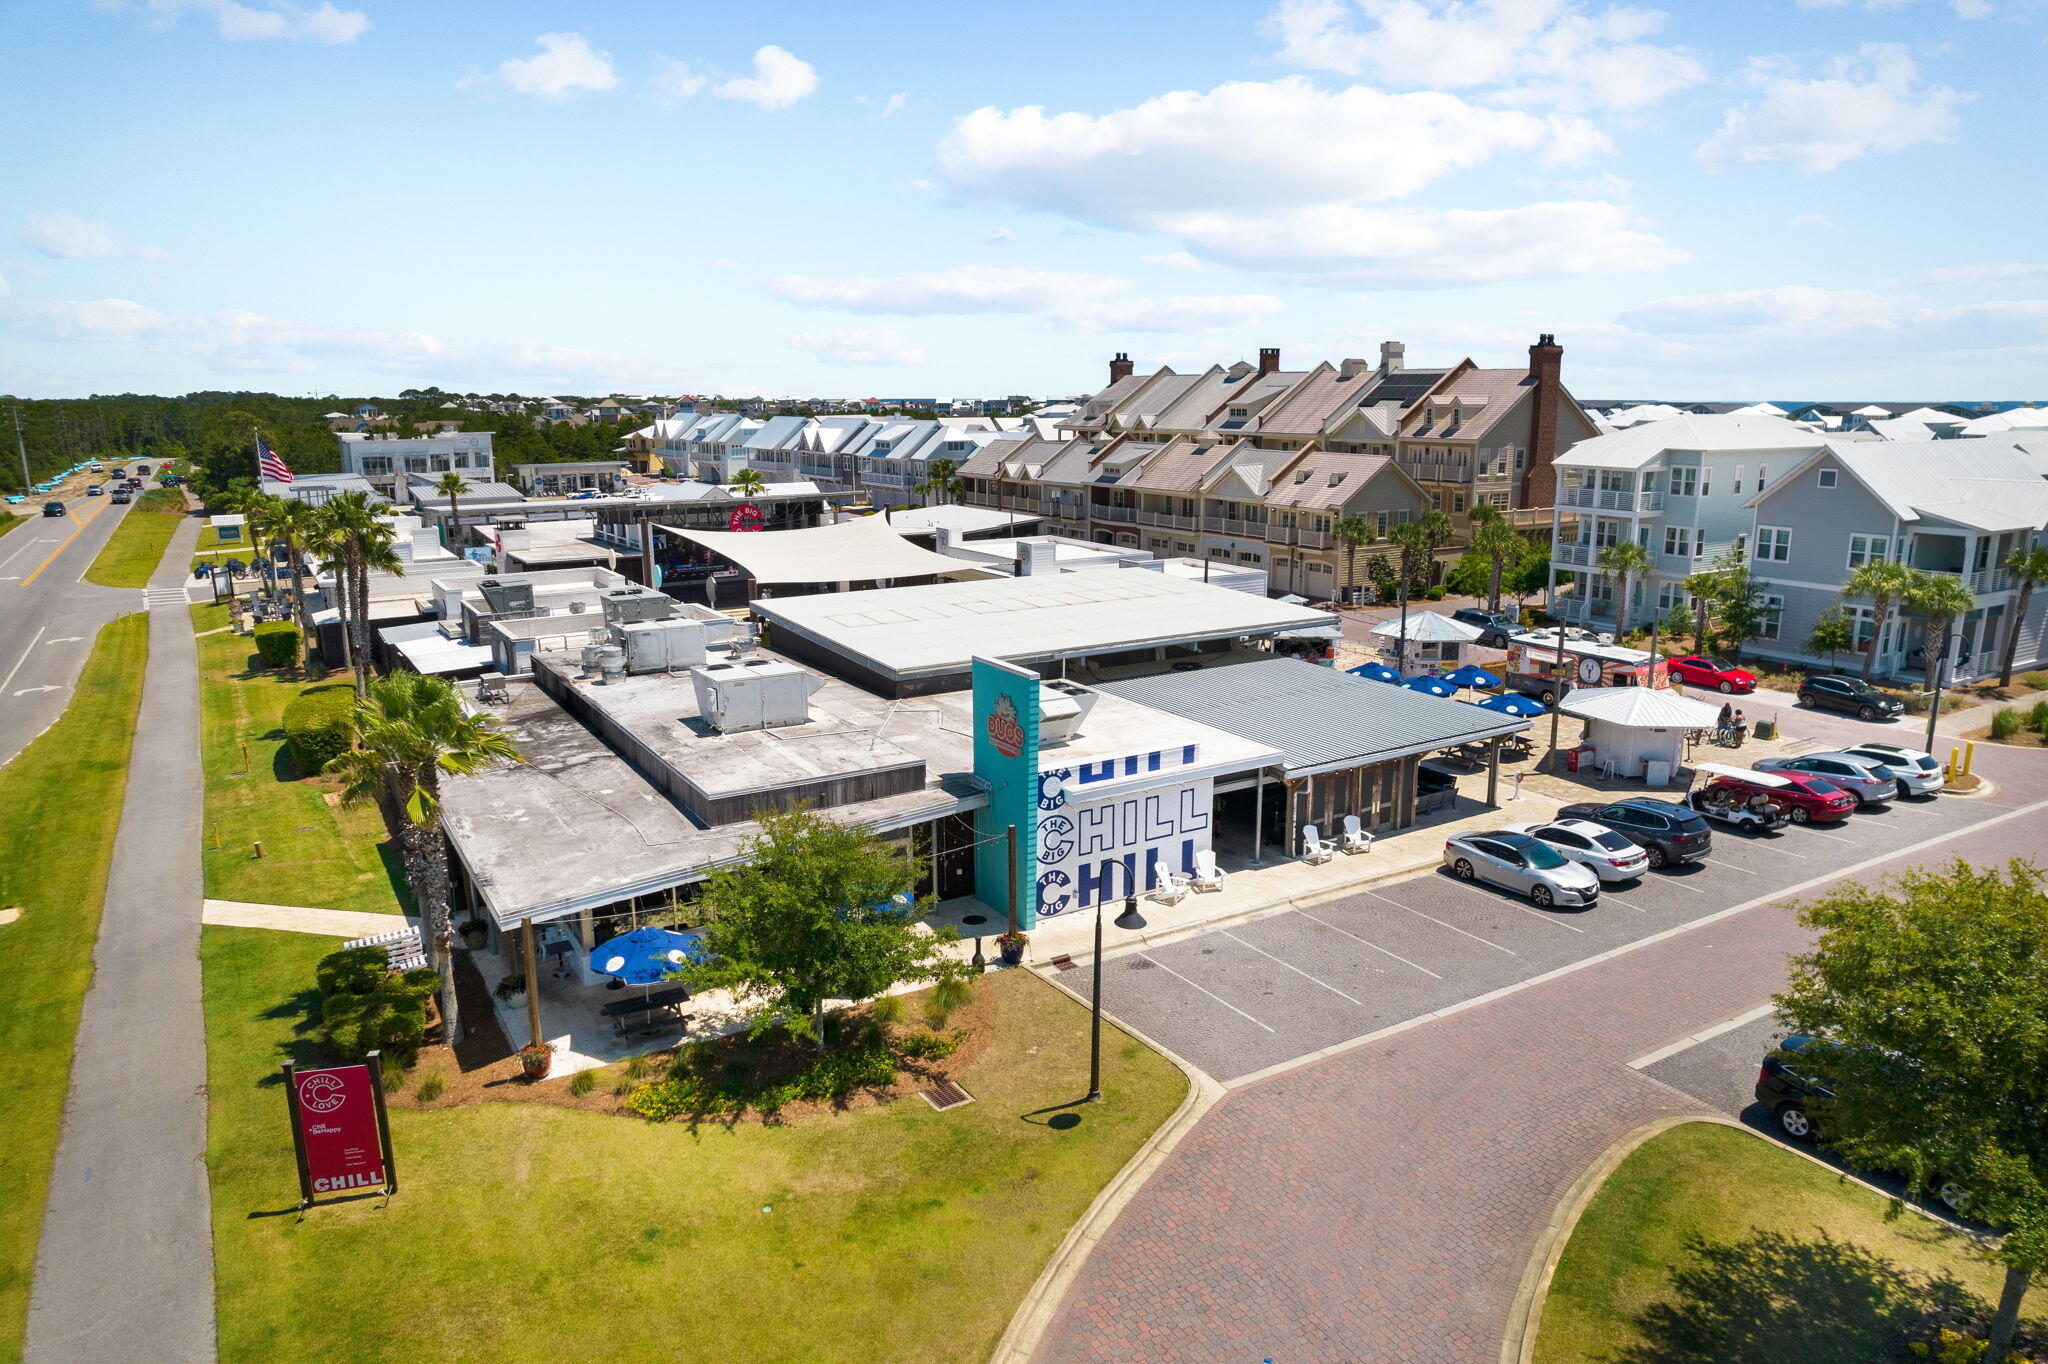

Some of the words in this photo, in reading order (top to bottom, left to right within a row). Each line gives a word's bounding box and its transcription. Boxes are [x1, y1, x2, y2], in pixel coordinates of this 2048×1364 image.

[733, 510, 743, 525] THE
[744, 507, 758, 517] BIG
[987, 715, 1023, 746] DUOS
[1040, 796, 1065, 809] BIG
[1041, 819, 1067, 832] THE
[1042, 847, 1065, 861] BIG
[1039, 873, 1066, 886] THE
[1040, 900, 1064, 915] BIG
[307, 1077, 336, 1089] CHILL
[312, 1098, 339, 1110] LOVE
[314, 1172, 382, 1191] CHILL
